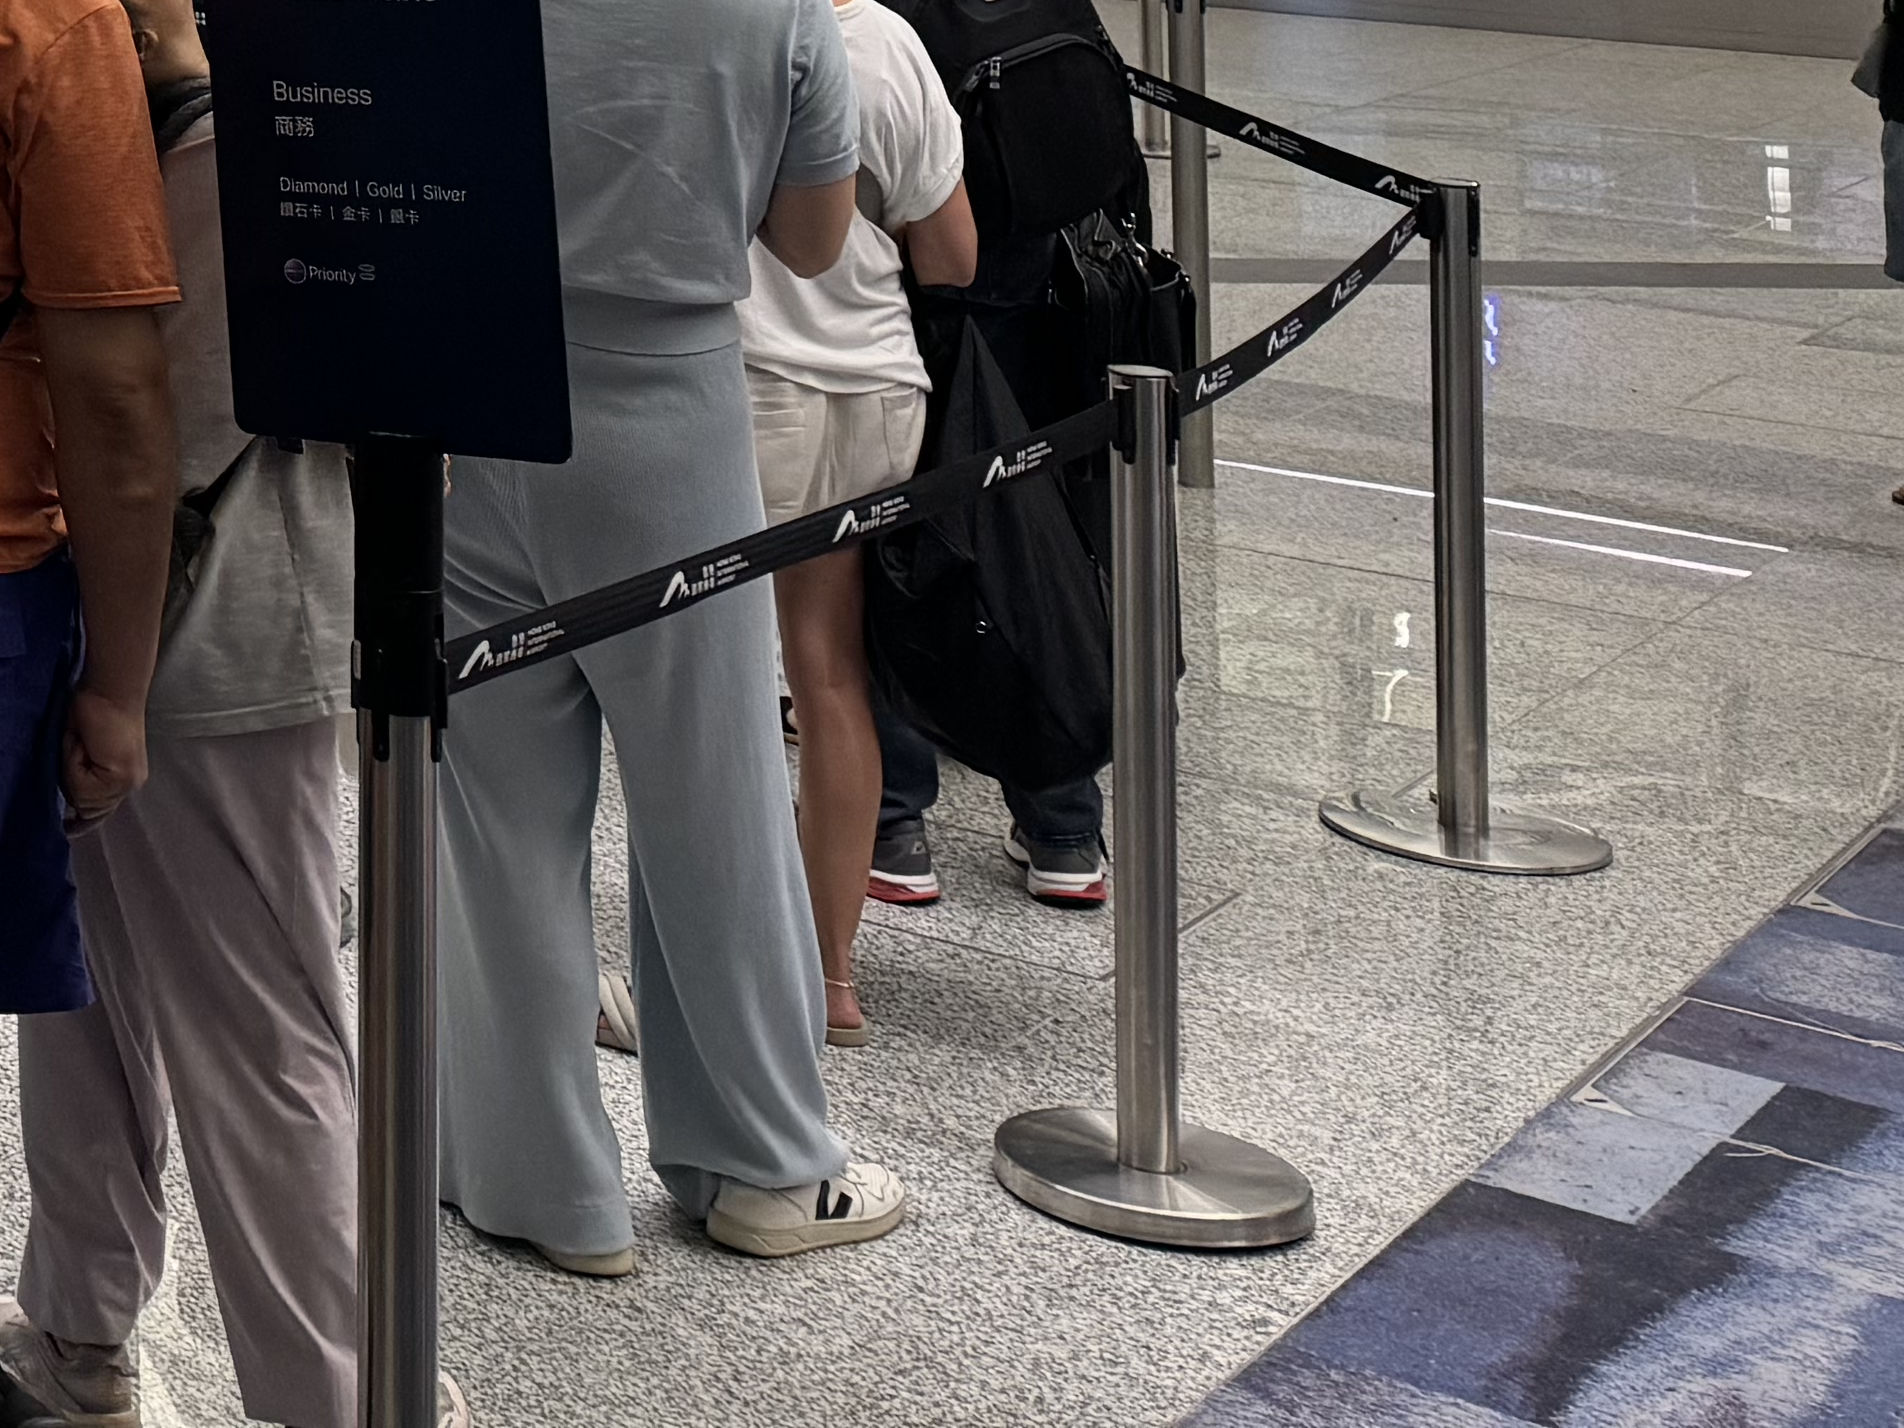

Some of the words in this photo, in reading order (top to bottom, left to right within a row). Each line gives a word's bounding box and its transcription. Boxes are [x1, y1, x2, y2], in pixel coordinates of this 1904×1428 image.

[272, 80, 373, 107] Business
[274, 115, 316, 139] 商務
[279, 176, 348, 196] Diamond
[366, 180, 404, 199] Gold
[422, 184, 468, 203] Silver
[308, 265, 358, 286] Priority
